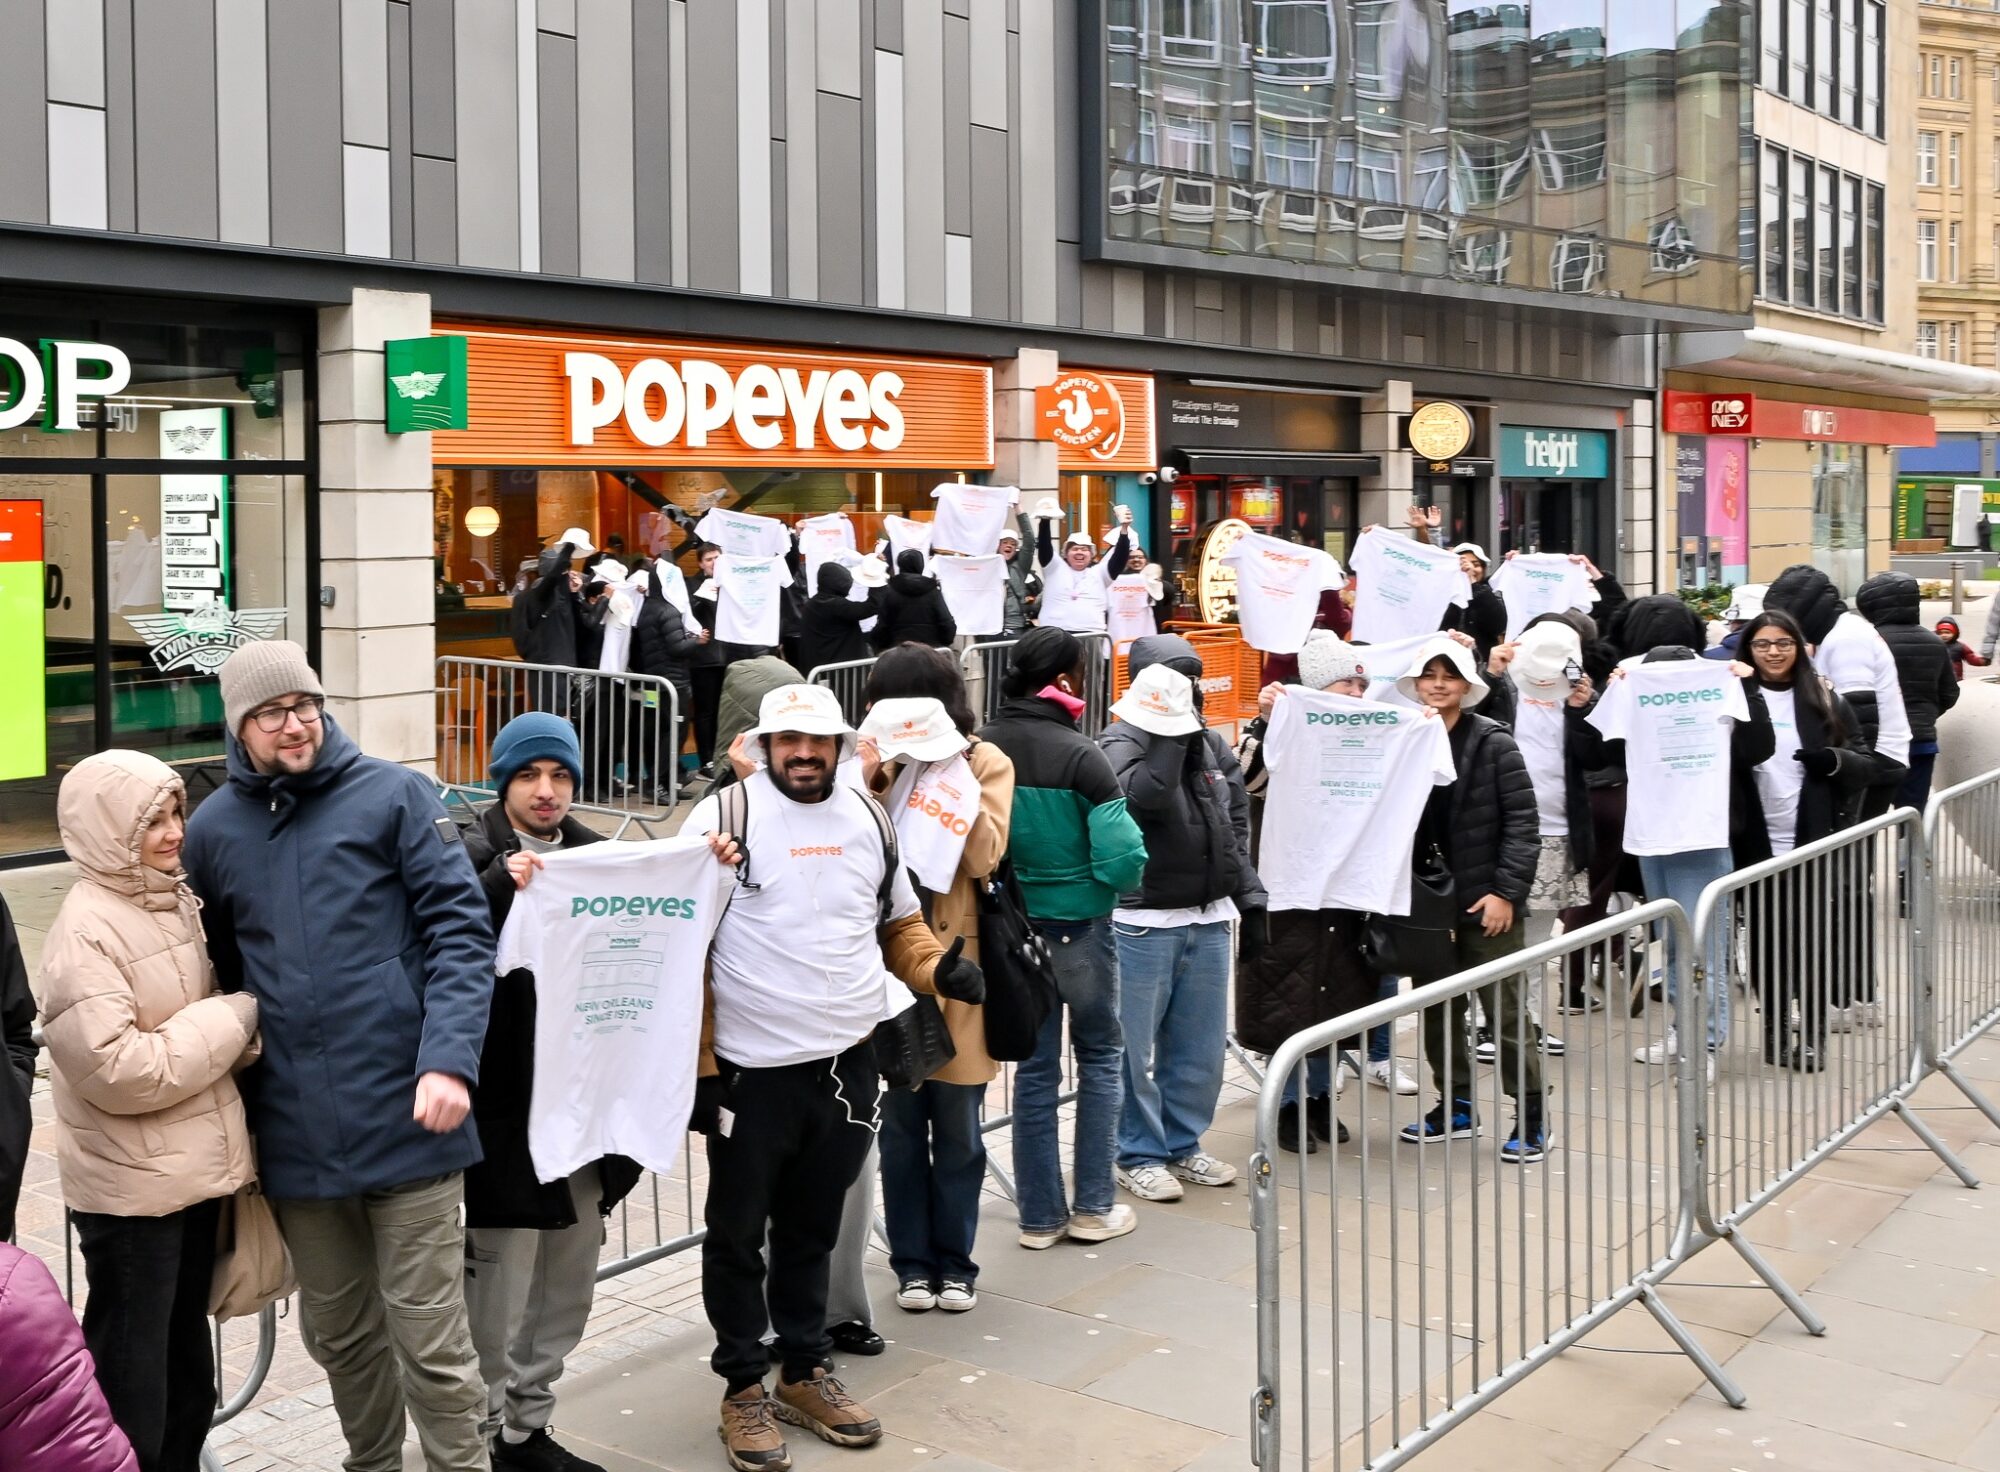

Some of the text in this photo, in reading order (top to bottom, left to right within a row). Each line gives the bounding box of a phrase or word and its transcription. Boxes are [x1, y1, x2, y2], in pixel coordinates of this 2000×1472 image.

[1054, 377, 1100, 395] POPEYES
[1711, 414, 1749, 428] NEY
[1053, 426, 1102, 445] CHICKEN
[182, 570, 190, 578] THE
[1344, 780, 1383, 789] ORLEANS
[1330, 789, 1355, 797] SINCE
[574, 997, 654, 1013] NEW ORLEANS
[585, 1009, 639, 1025] SINCE 1972
